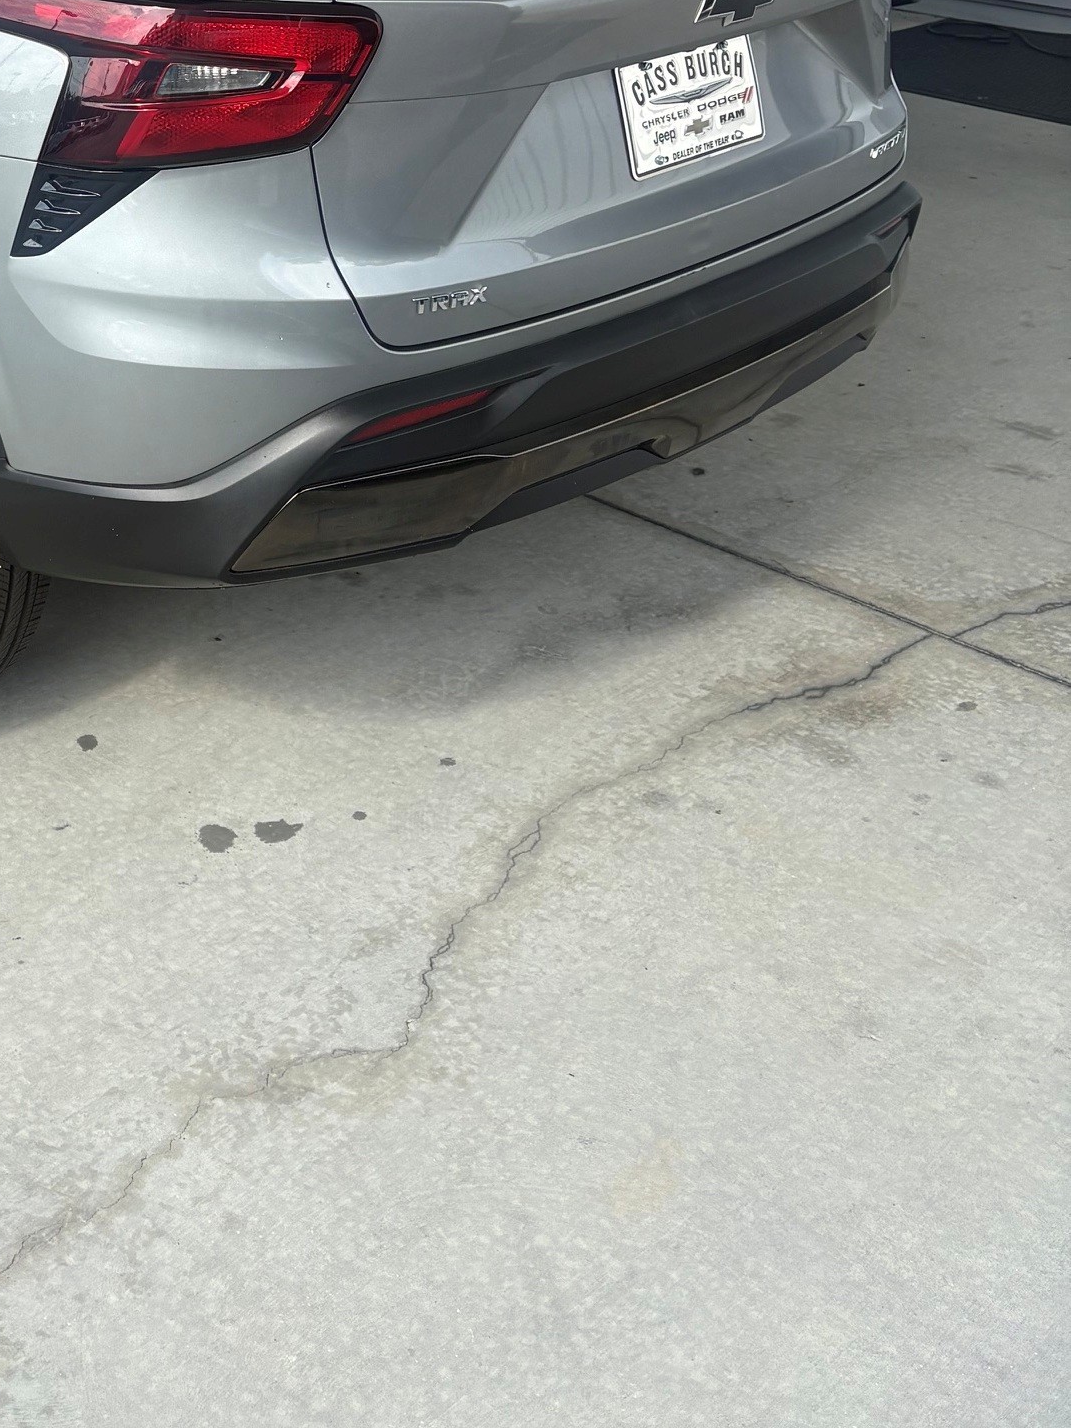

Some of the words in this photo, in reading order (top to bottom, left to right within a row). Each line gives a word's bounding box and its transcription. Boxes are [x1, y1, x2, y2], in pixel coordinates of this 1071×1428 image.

[631, 60, 678, 106] CASS
[685, 51, 743, 80] BURCH
[642, 108, 690, 129] CHRYSLER
[697, 92, 745, 112] DODGE
[653, 129, 676, 146] Jeep
[719, 109, 745, 124] RAM
[672, 147, 694, 161] DEALER
[695, 145, 702, 153] OF
[703, 141, 714, 150] THE
[715, 136, 729, 147] YEAR
[412, 286, 488, 314] TRAX
